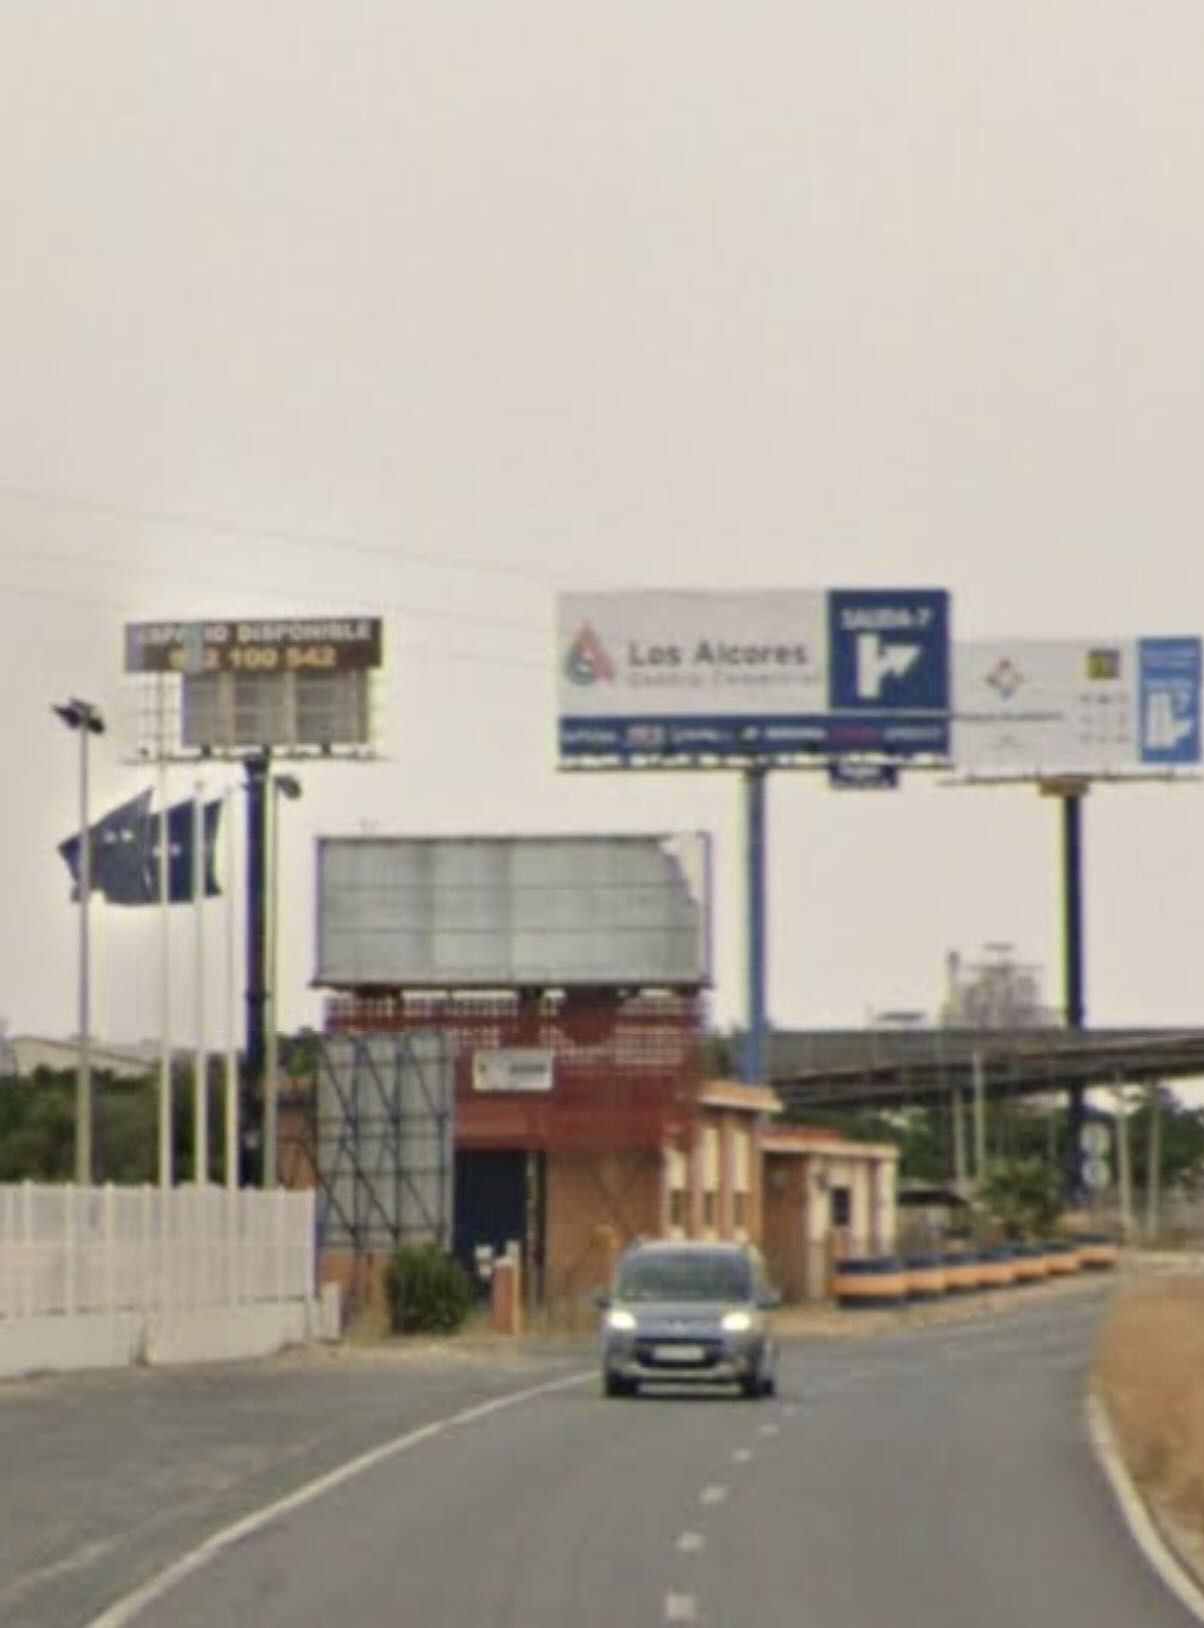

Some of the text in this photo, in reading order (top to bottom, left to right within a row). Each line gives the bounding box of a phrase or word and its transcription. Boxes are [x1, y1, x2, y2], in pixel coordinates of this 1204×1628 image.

[237, 621, 371, 642] DISPONIBLE
[229, 645, 279, 669] 100
[628, 641, 807, 666] Los Alcores
